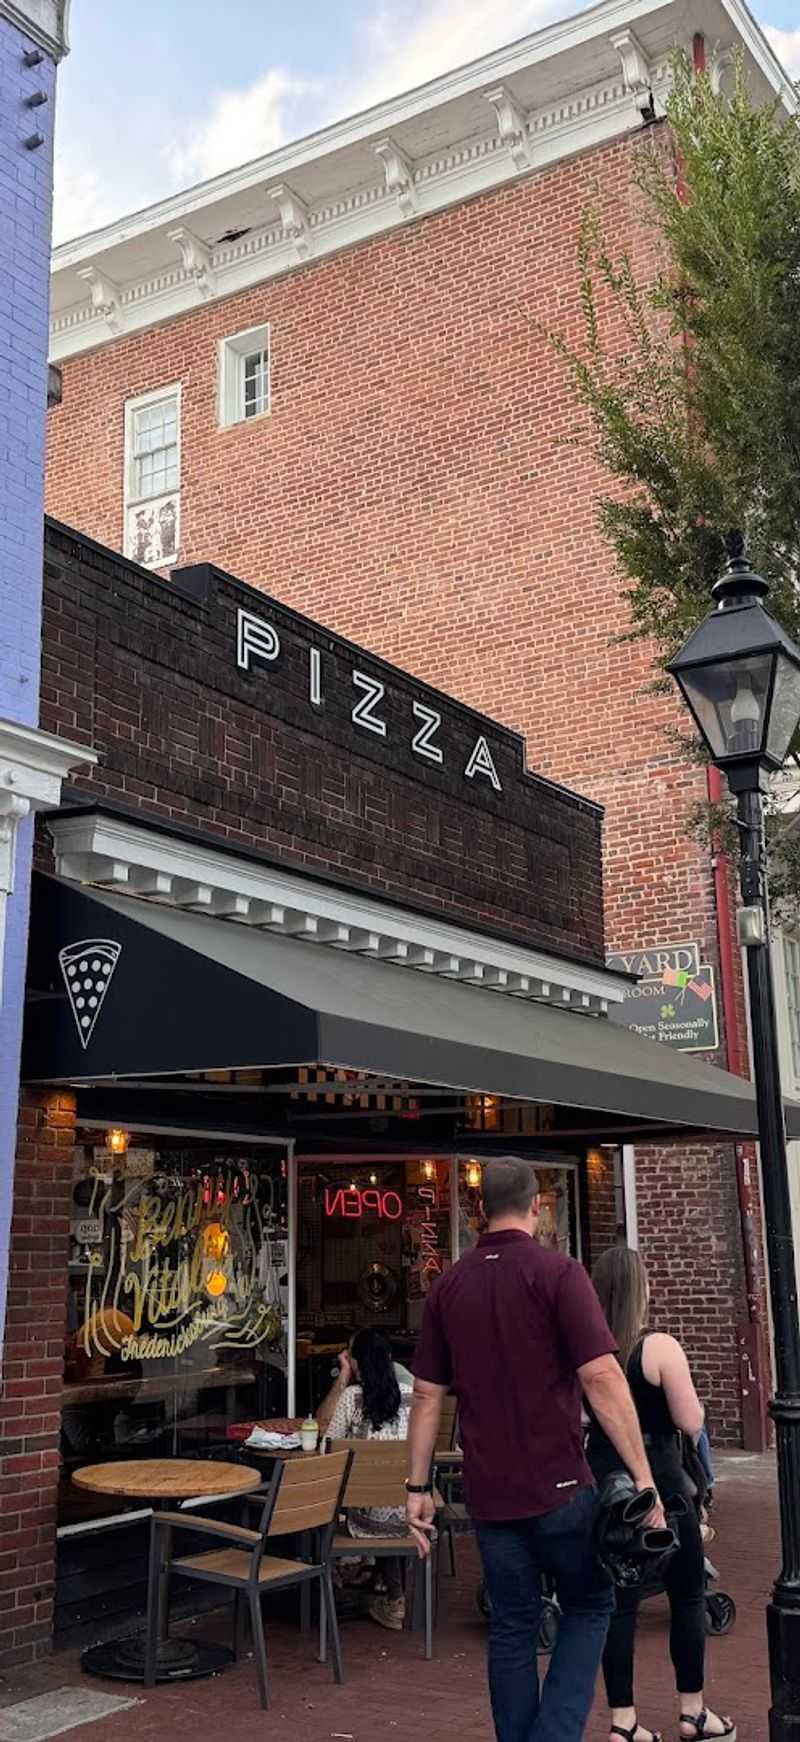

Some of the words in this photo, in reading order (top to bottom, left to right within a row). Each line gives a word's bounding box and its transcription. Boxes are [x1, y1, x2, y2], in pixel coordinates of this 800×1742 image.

[237, 608, 502, 791] PIZZA
[628, 1023, 657, 1035] Open
[657, 1018, 710, 1032] Seasonally
[658, 1029, 700, 1042] Friendly
